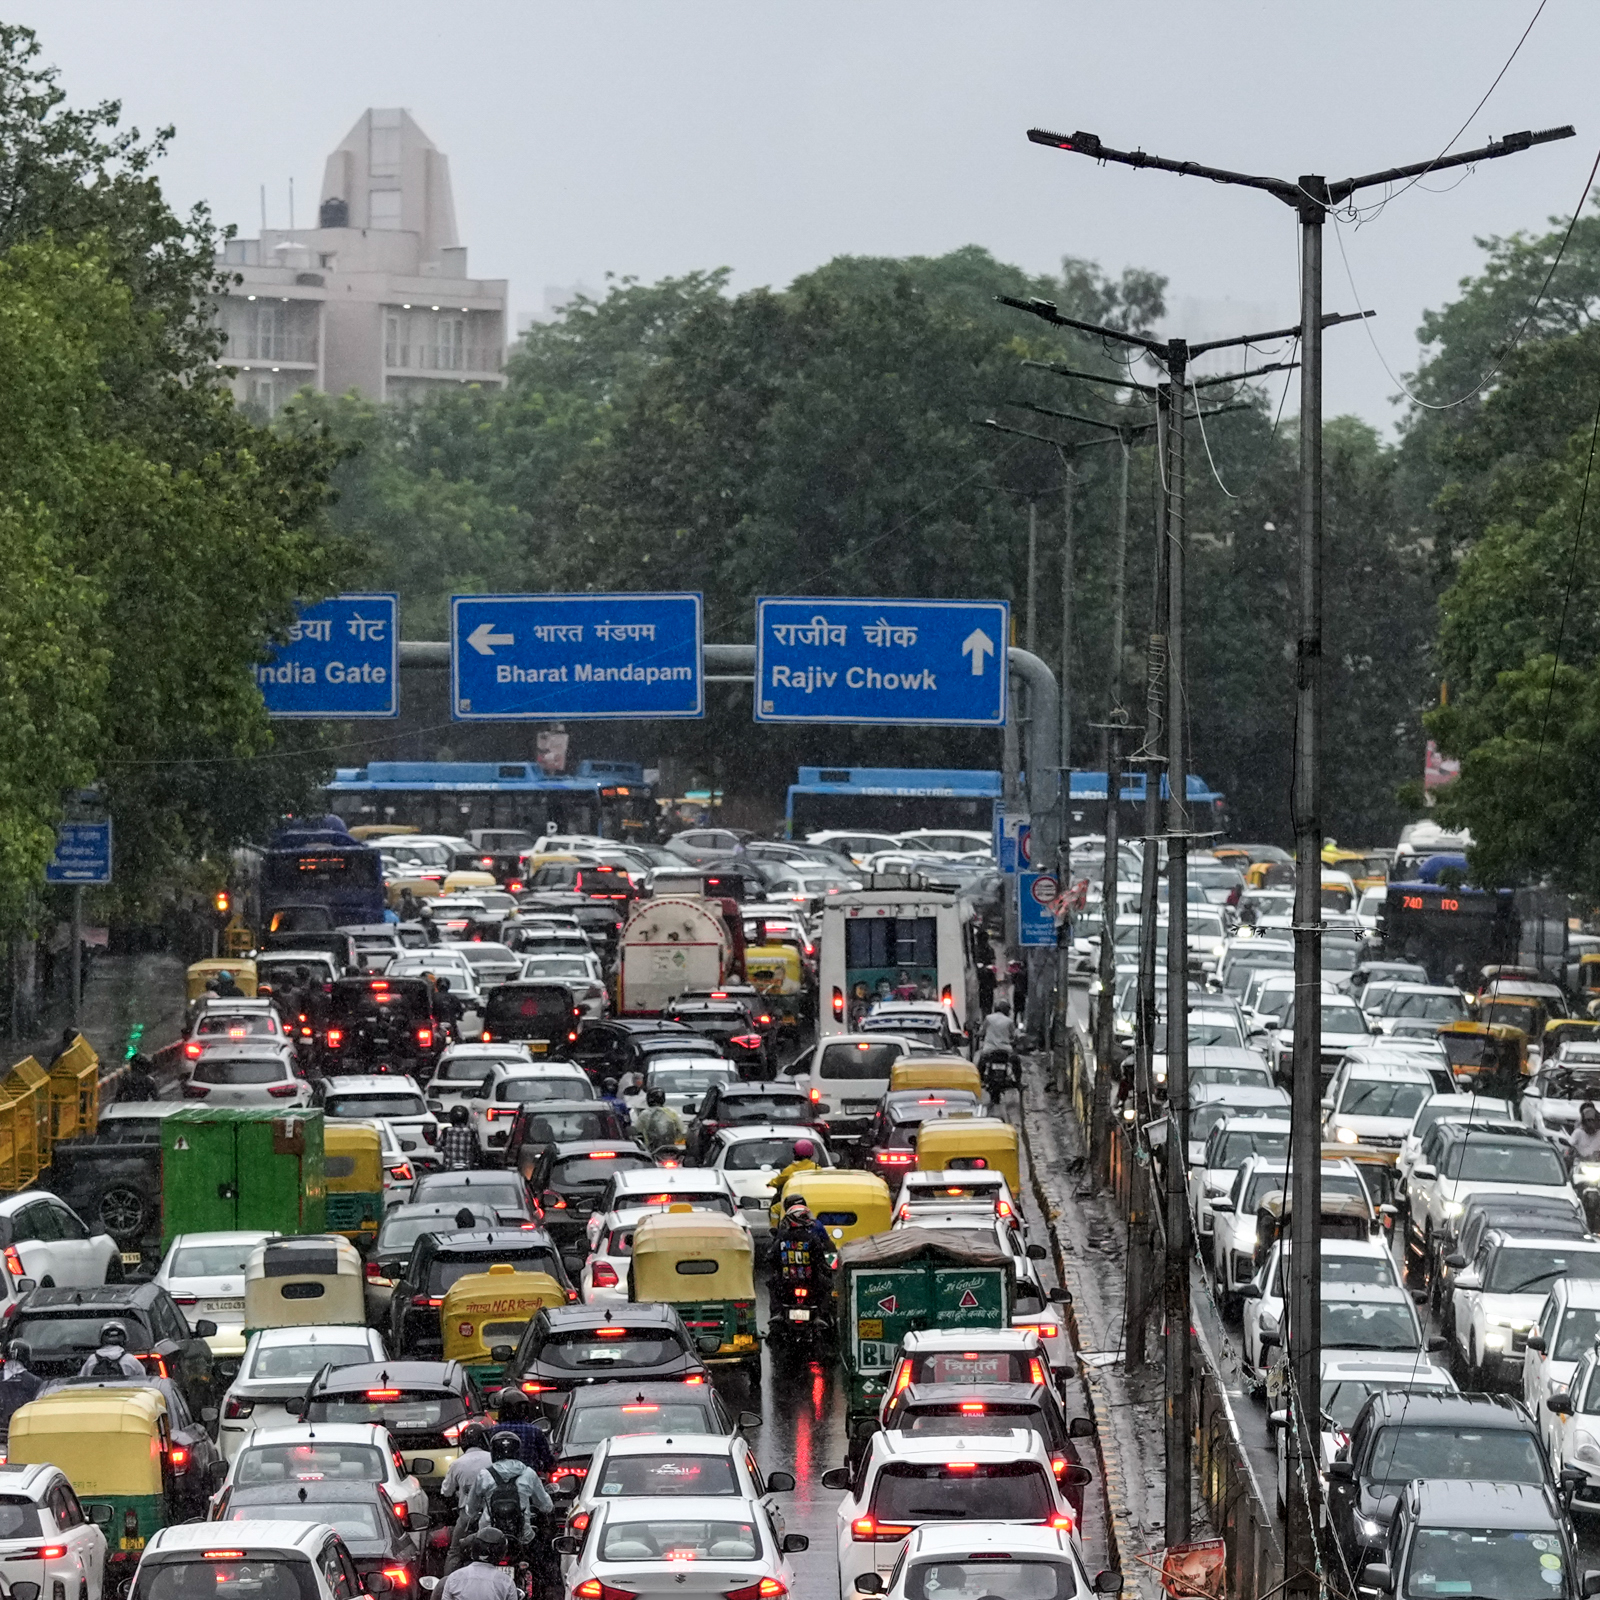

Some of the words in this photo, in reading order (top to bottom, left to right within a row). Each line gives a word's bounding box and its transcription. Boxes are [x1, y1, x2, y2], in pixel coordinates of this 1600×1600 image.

[347, 612, 386, 641] गेट
[533, 622, 584, 645] भारत
[594, 618, 656, 645] मंडपम
[771, 615, 848, 647] राजीव
[860, 617, 919, 647] चौक
[324, 661, 386, 685] Gate
[496, 664, 569, 685] Bharat
[573, 663, 693, 692] Mandapam
[771, 666, 839, 694] Rajiv
[844, 667, 938, 692] Chowk
[861, 787, 898, 797] 100%
[900, 788, 954, 797] ELECTRIC
[1403, 896, 1423, 909] 740
[1440, 898, 1459, 911] ITO
[206, 1300, 246, 1311] DL14CD493
[492, 1299, 517, 1314] NCR
[517, 1296, 543, 1312] दिल्ली
[862, 1344, 897, 1367] BL
